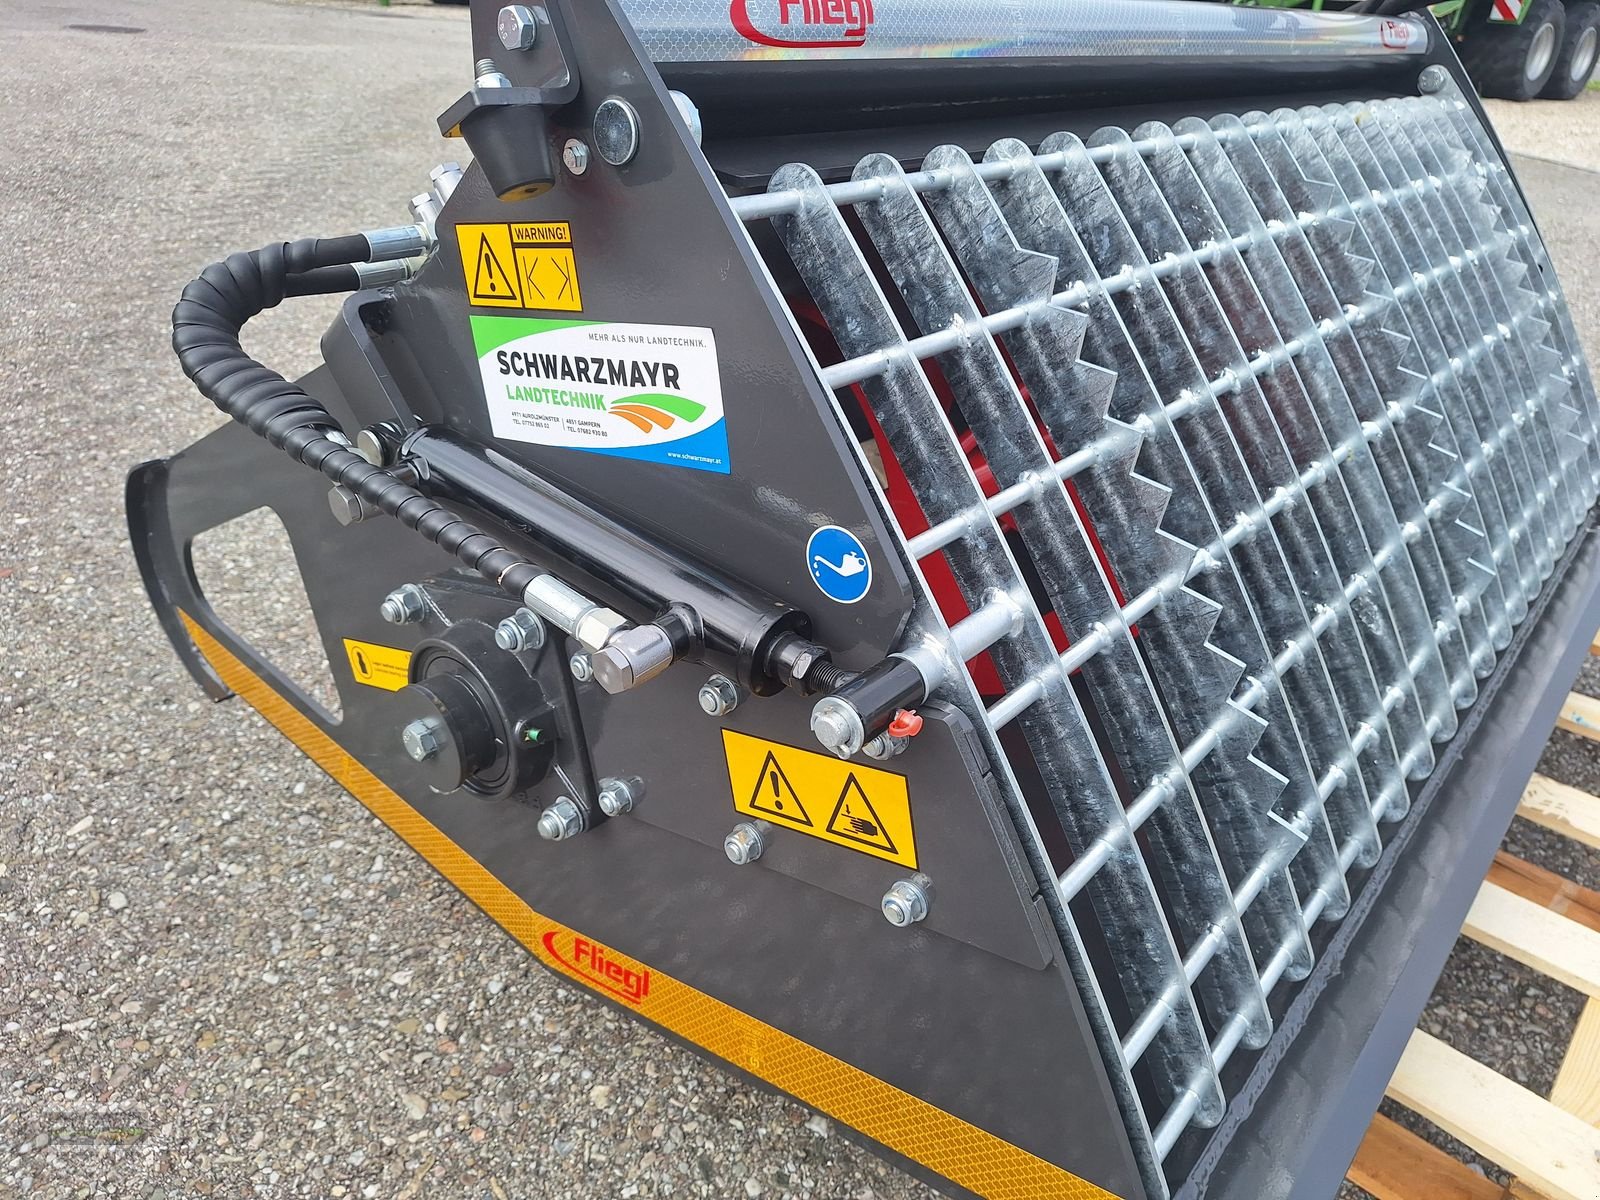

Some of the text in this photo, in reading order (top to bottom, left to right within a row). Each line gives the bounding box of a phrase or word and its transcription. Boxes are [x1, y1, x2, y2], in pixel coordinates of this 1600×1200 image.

[514, 226, 567, 240] WARNING!
[588, 333, 707, 348] MEHR ALS NUR LANDTECHNIK.
[496, 350, 681, 390] SCHWARZMAYR
[505, 384, 607, 411] LANDTECHNIK
[667, 452, 722, 465] www.schwarzmayr.at
[574, 937, 650, 999] Fliegl
